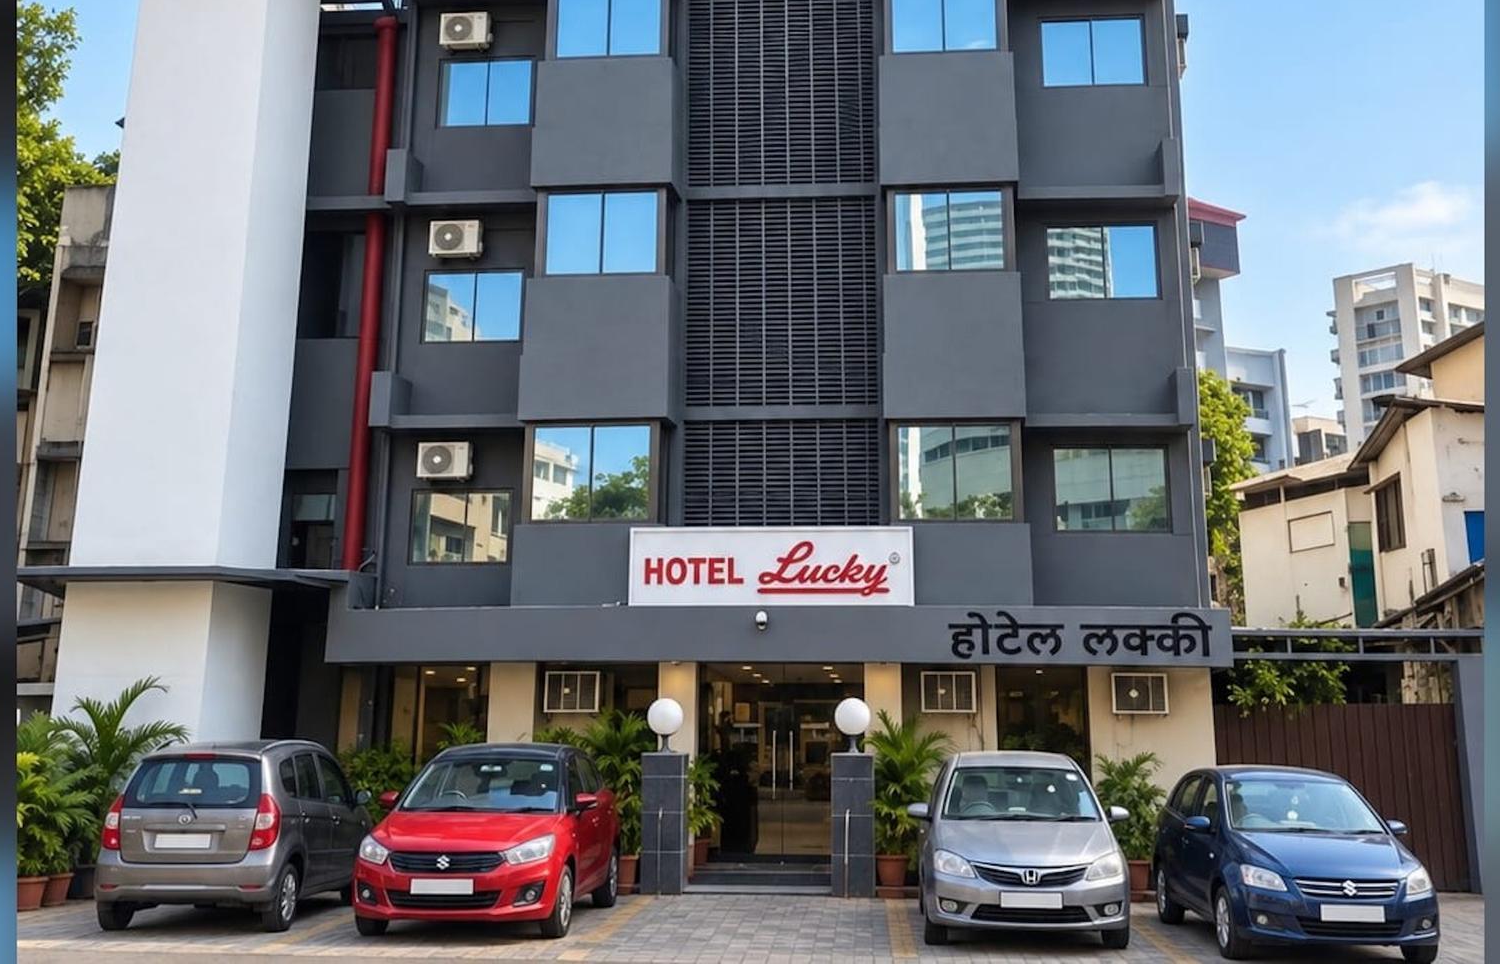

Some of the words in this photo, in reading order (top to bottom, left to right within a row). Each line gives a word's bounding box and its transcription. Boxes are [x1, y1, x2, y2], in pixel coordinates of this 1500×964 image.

[644, 557, 744, 586] HOTEL
[758, 540, 889, 597] Lucky
[948, 611, 1064, 659] होटेल
[1079, 612, 1212, 657] लक्की
